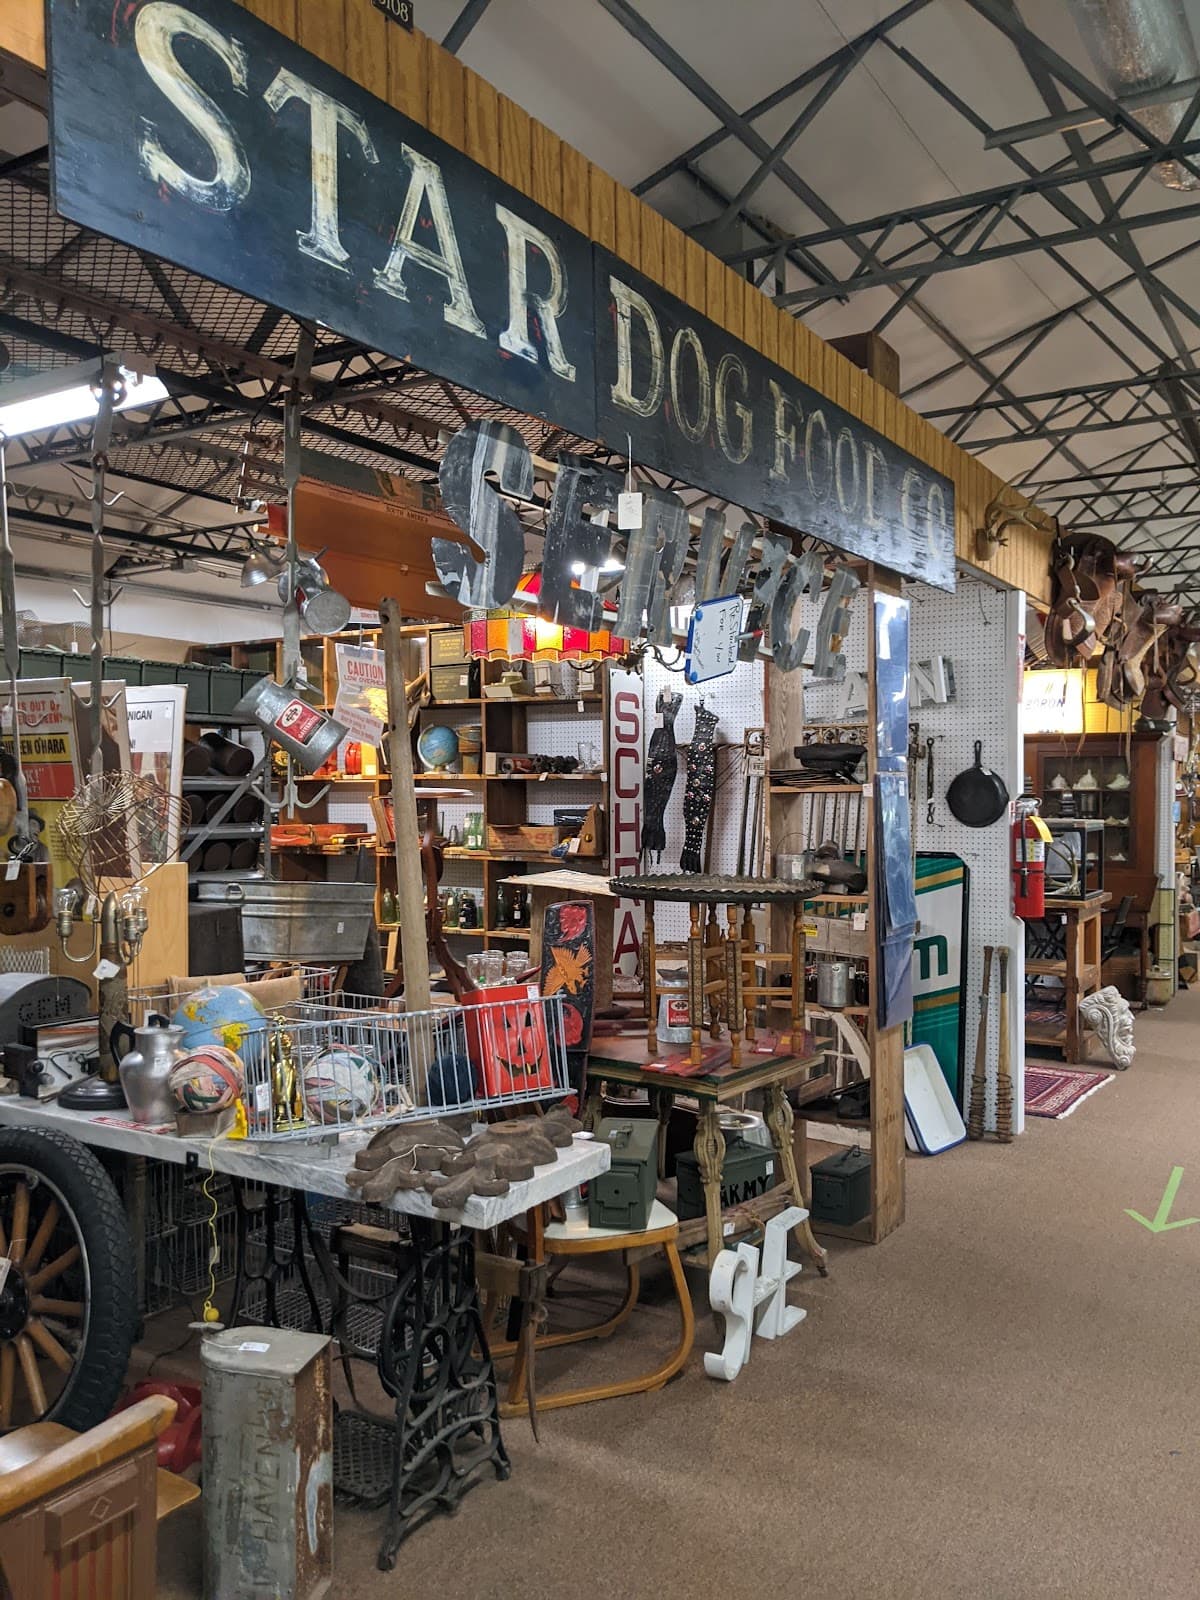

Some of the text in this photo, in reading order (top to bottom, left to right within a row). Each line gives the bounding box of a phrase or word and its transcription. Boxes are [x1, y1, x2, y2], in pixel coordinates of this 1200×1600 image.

[134, 0, 576, 382] STAR
[609, 275, 753, 464] DOG
[769, 378, 890, 528] FOOD
[346, 660, 384, 679] CAUTION
[34, 737, 66, 754] O'HARA
